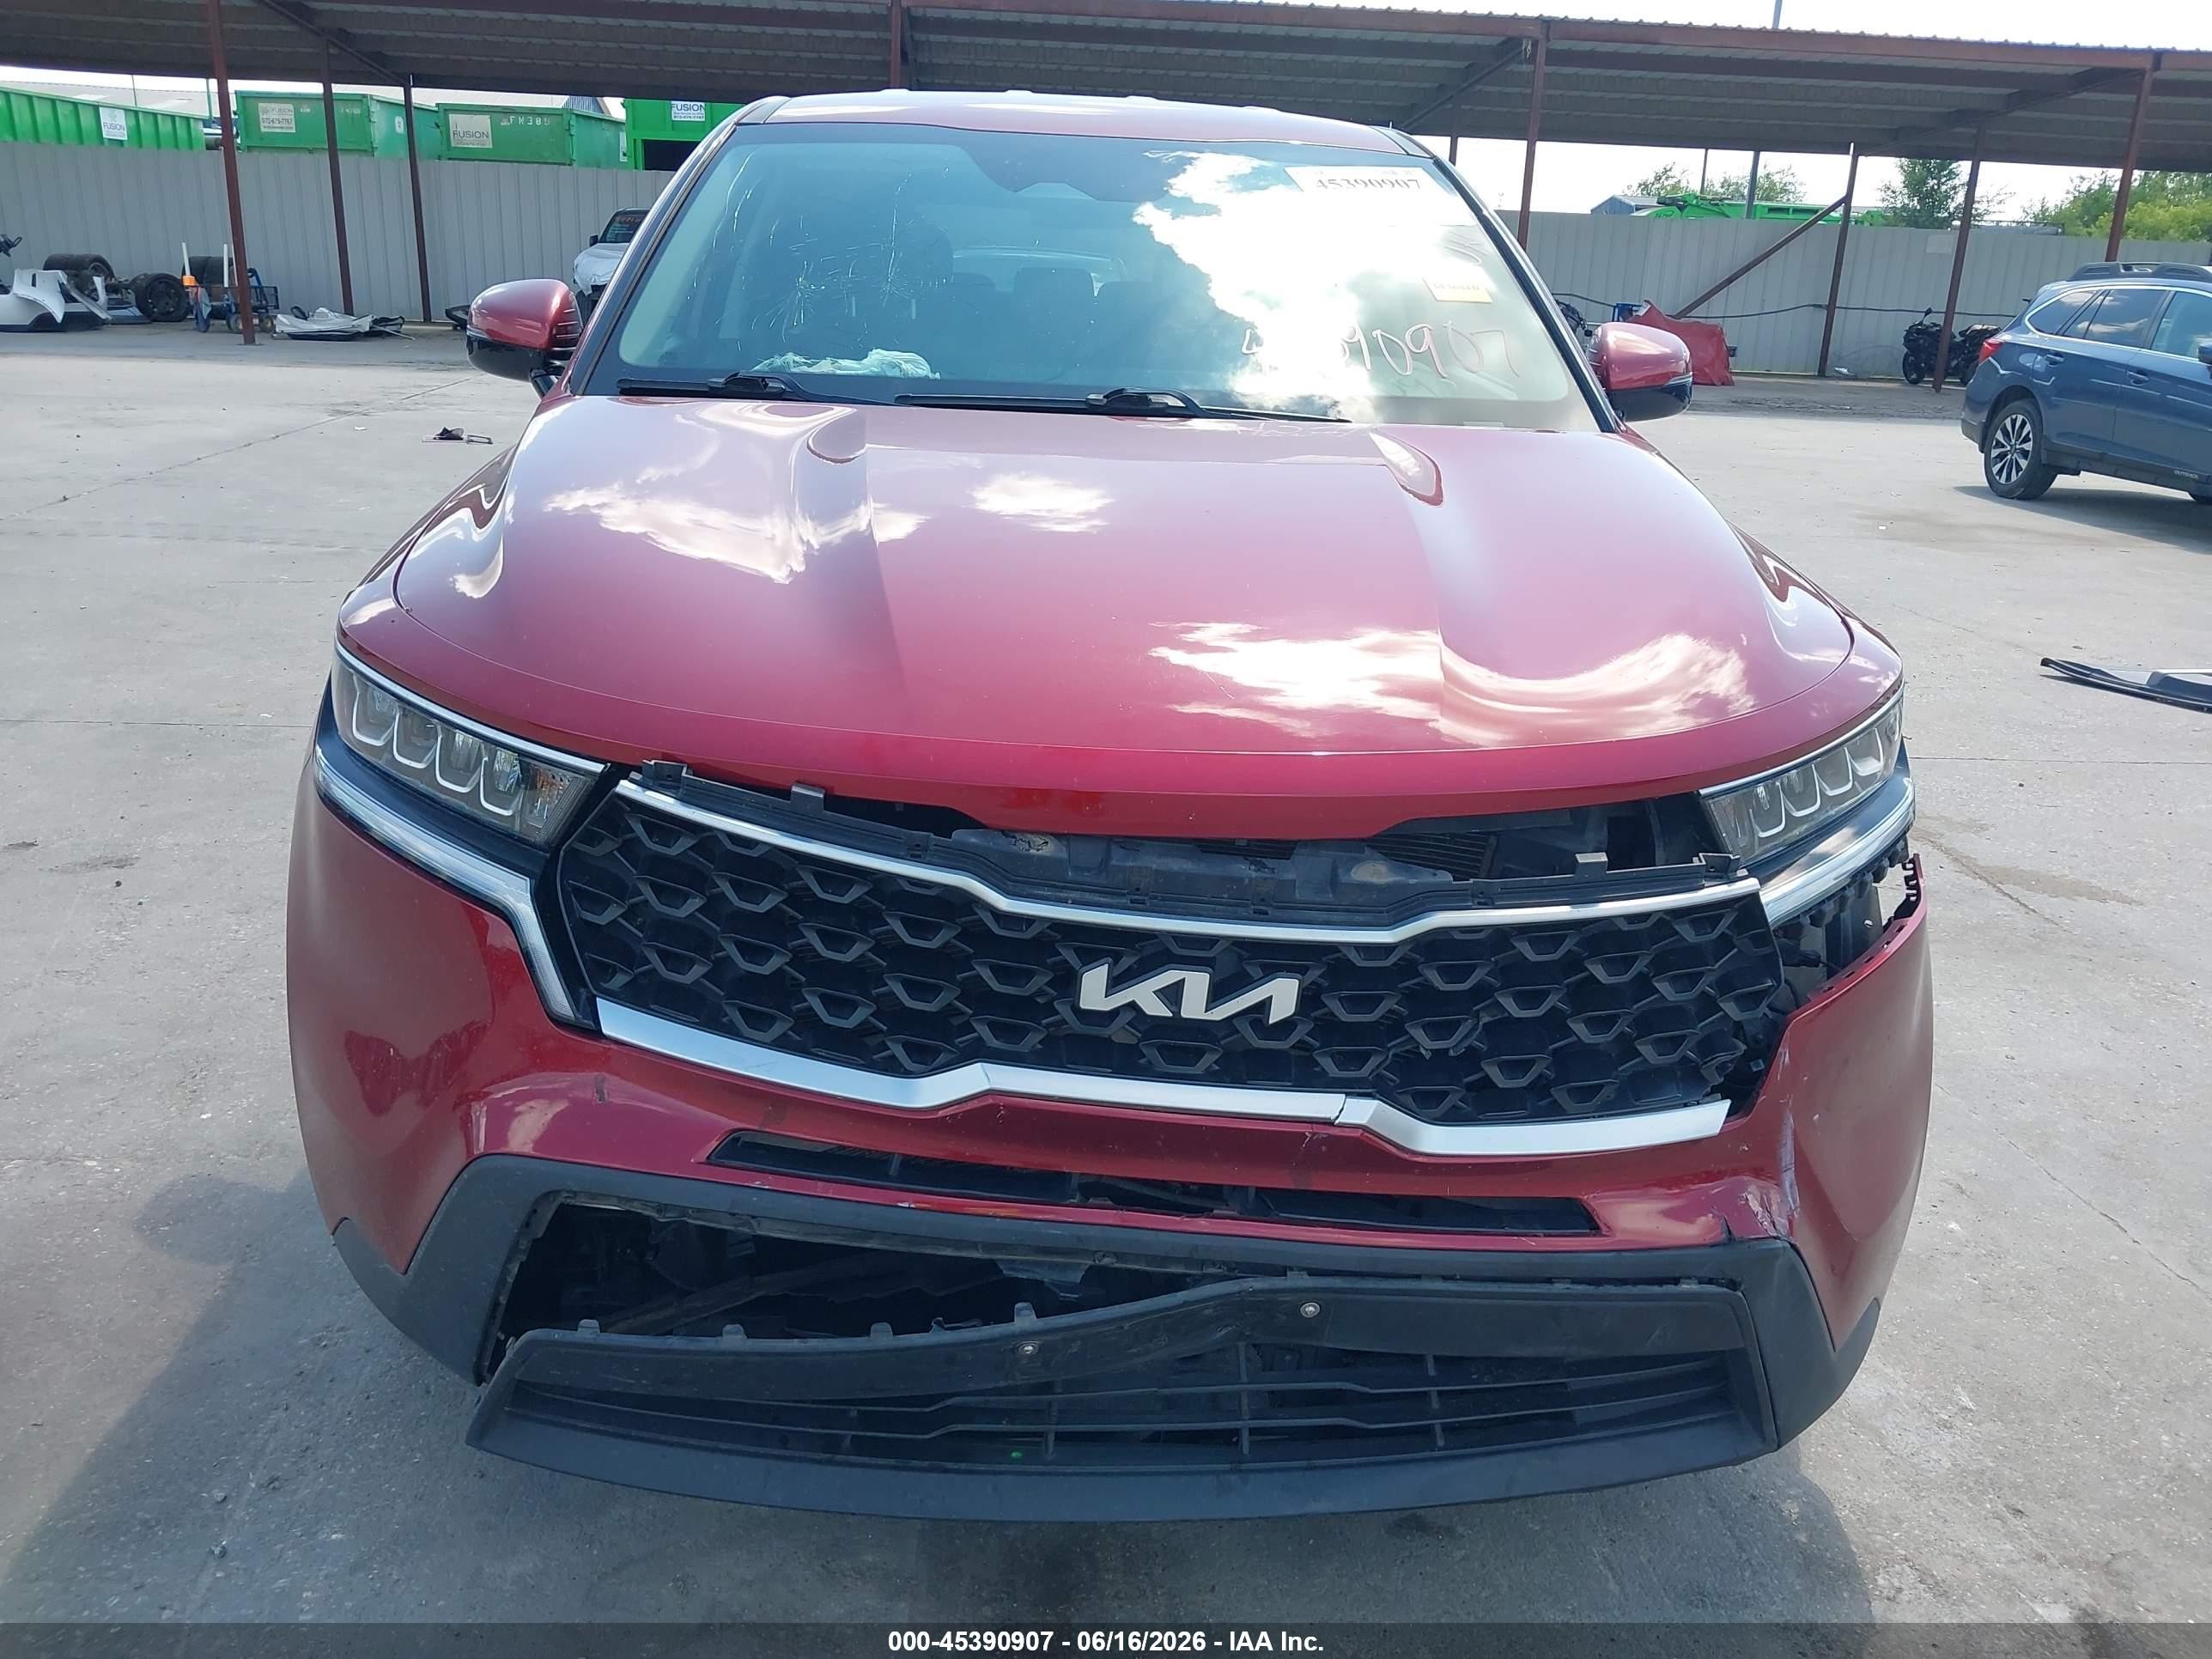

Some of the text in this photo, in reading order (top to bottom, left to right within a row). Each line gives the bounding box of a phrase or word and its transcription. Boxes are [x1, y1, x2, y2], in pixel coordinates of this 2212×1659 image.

[671, 102, 706, 112] FUSION
[102, 122, 125, 131] FUSION
[453, 130, 489, 138] FUSION
[1079, 963, 1300, 1024] KIA
